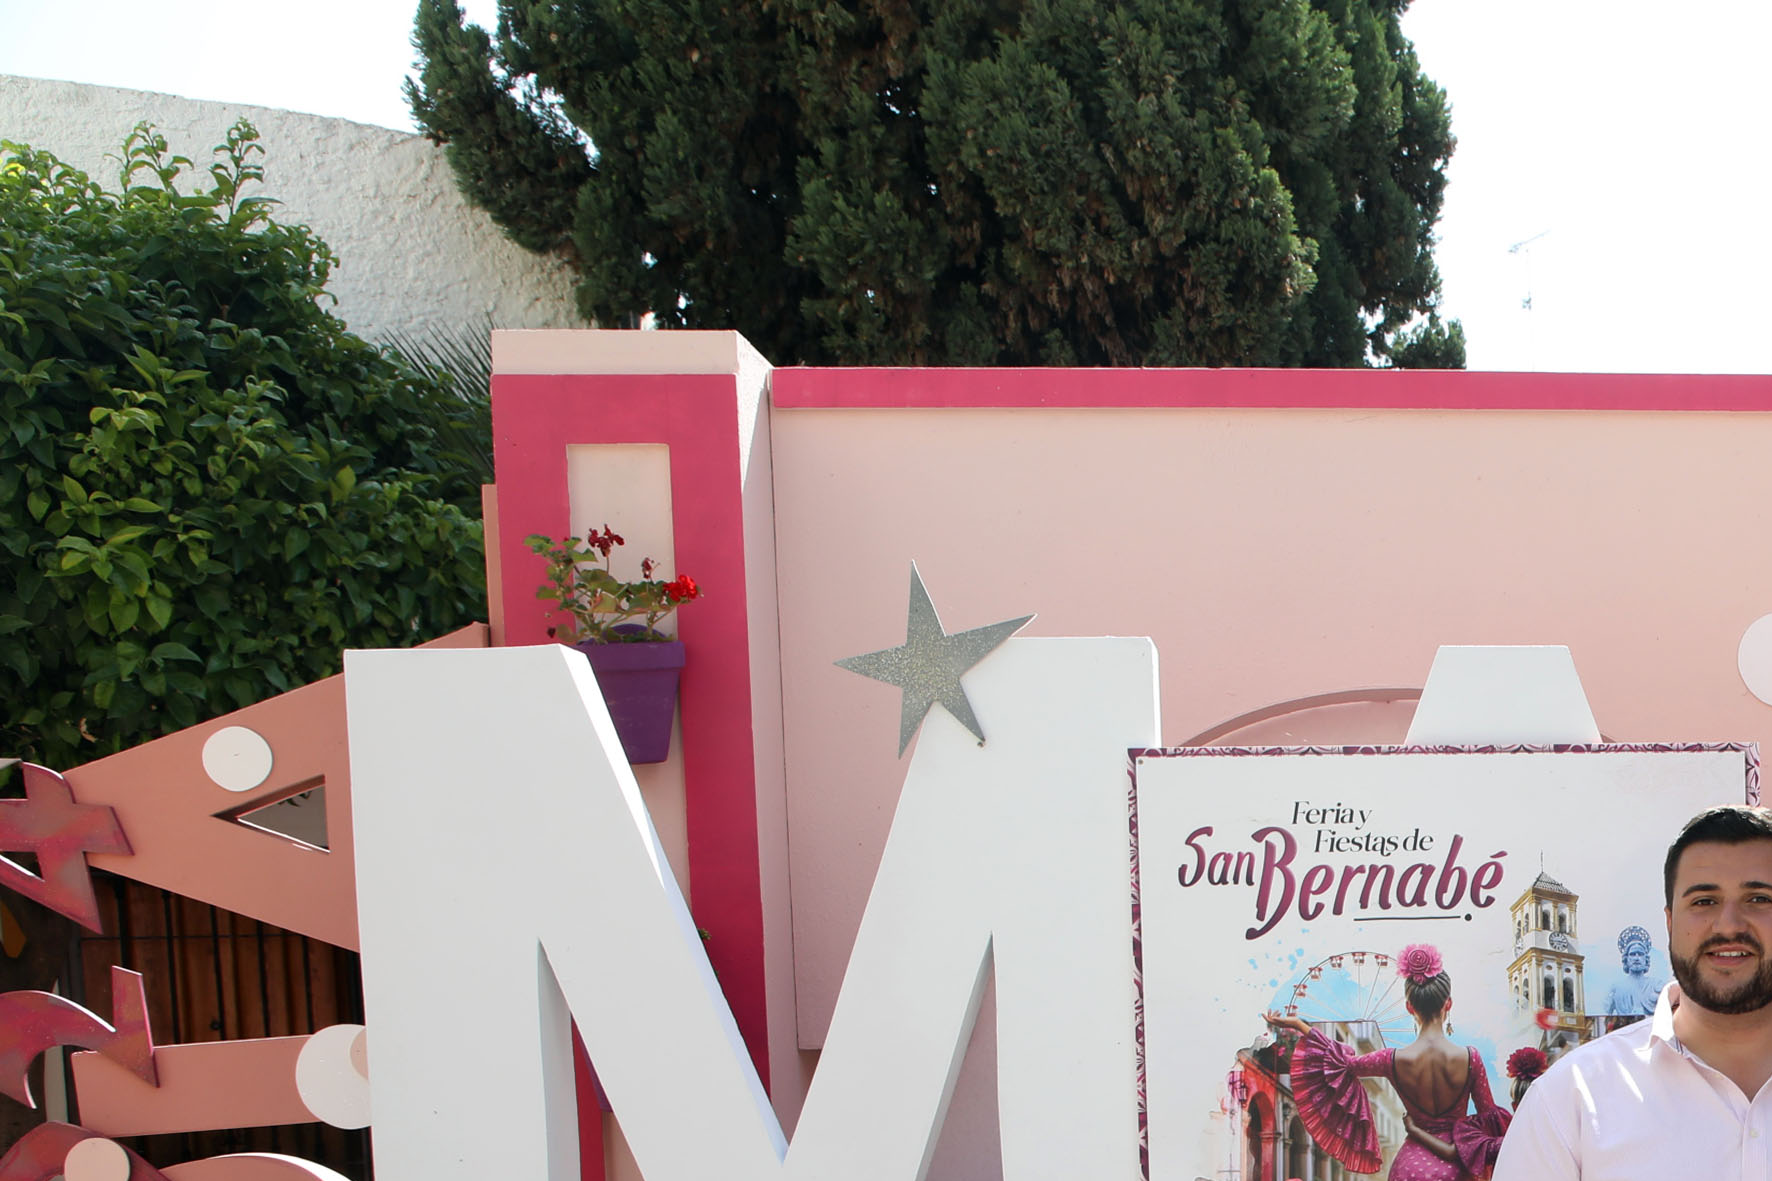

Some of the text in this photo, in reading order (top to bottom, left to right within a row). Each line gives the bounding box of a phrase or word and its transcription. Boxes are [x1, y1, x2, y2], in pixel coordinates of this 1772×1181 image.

[1291, 800, 1373, 831] Feria y
[1314, 828, 1434, 857] Fiestas de
[1178, 826, 1508, 941] San Bernabé
